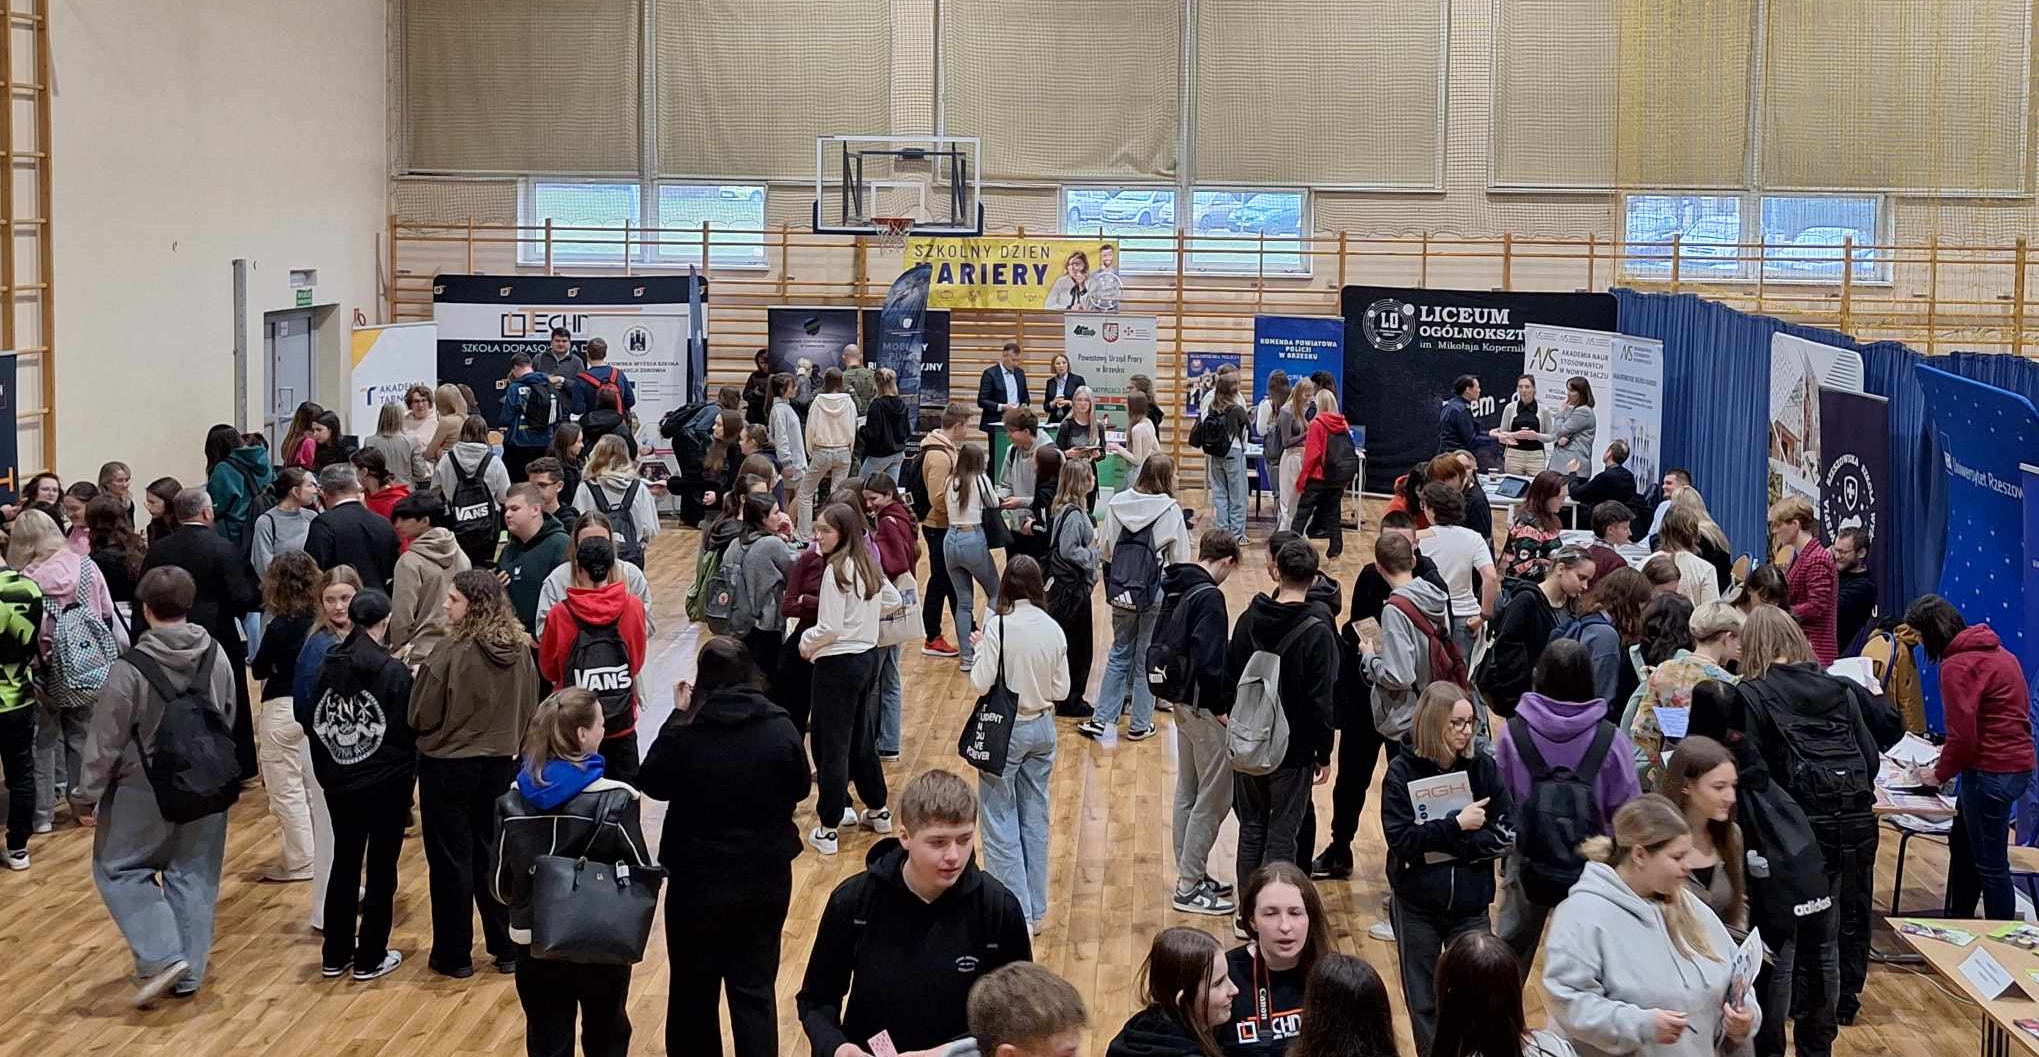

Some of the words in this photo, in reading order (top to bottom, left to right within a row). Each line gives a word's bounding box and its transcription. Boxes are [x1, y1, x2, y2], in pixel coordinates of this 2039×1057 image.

[914, 244, 991, 259] SZKOLNY
[1001, 242, 1050, 259] DZIEŃ
[916, 262, 1048, 286] ARIERY
[1381, 312, 1399, 328] LO
[1419, 305, 1510, 325] LICEUM
[462, 343, 500, 353] SZKOŁA
[1295, 338, 1337, 348] POWIATOWA
[1438, 341, 1479, 353] Mikołaja
[1952, 456, 1987, 488] Uniwersytet
[455, 502, 489, 522] VANS
[574, 663, 632, 692] VANS
[1415, 782, 1466, 800] AGH
[1793, 896, 1832, 917] adidas
[1259, 987, 1268, 1021] Canon
